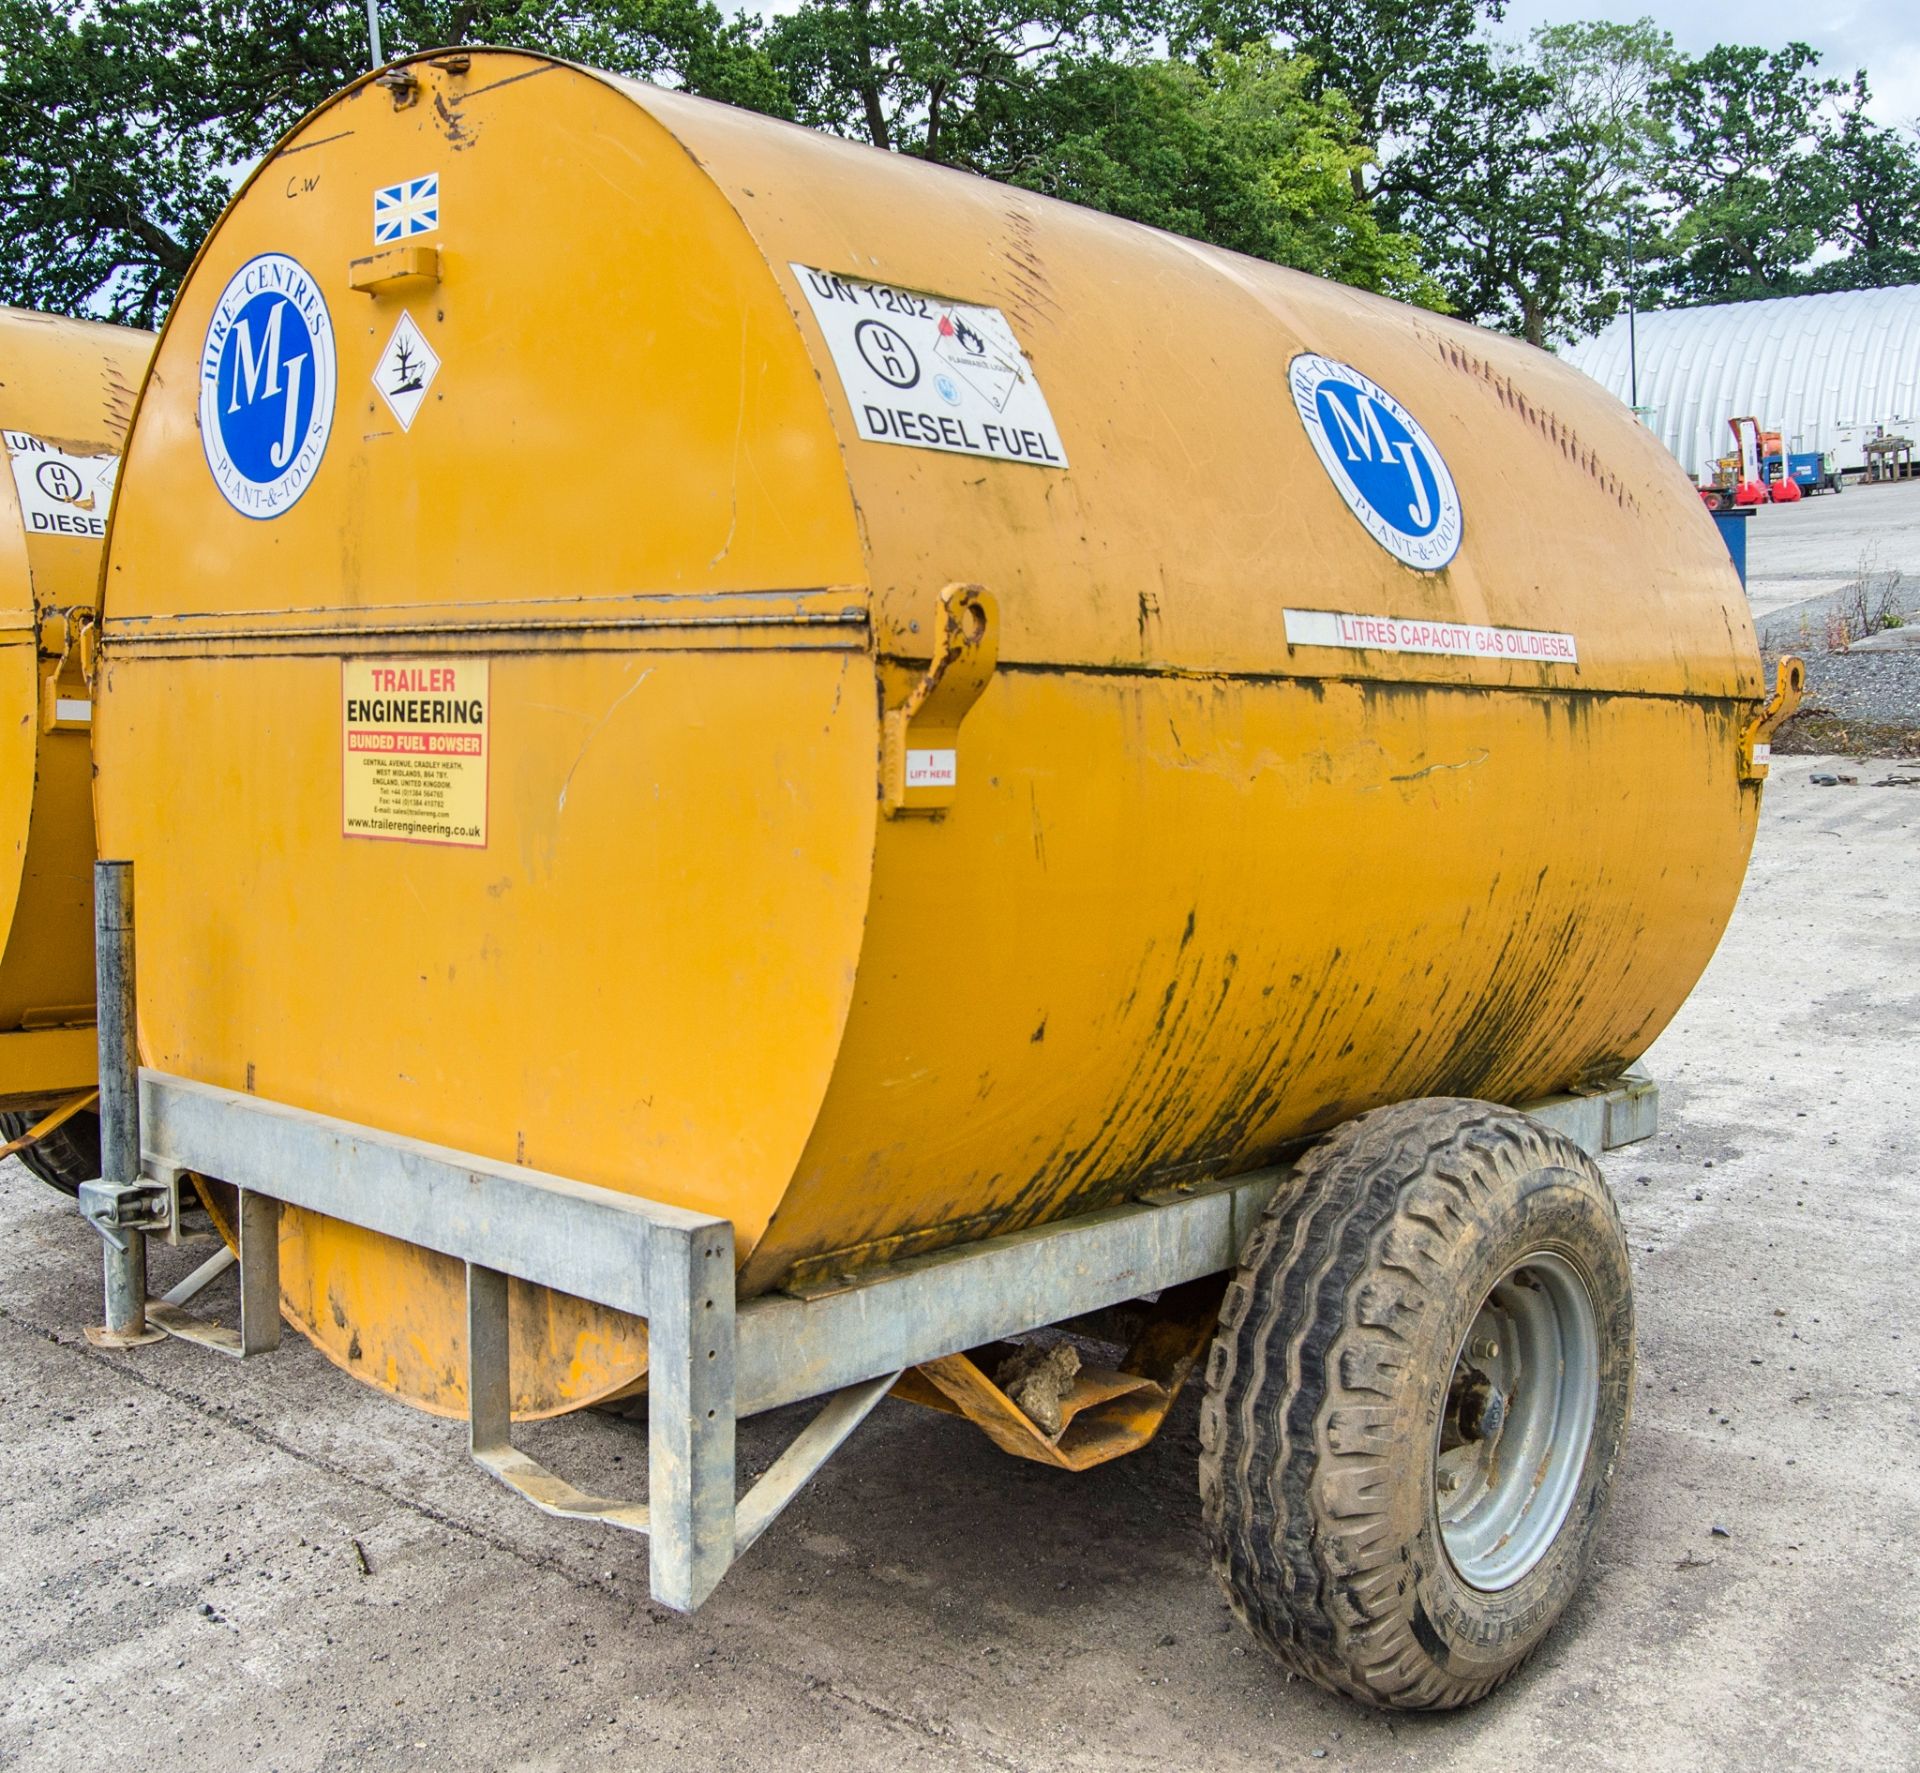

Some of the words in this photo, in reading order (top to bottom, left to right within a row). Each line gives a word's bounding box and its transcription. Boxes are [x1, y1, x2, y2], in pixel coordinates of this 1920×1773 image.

[807, 273, 858, 305] UN
[864, 286, 934, 320] 1202
[204, 299, 237, 381] HIRE
[244, 262, 326, 337] CENTRES
[227, 299, 308, 469] MJ
[1295, 367, 1319, 424] HIRE
[1311, 358, 1419, 436] CENTRES
[12, 435, 46, 453] UN
[863, 404, 980, 449] DIESEL
[982, 423, 1060, 461] FUEL
[1317, 388, 1432, 528] MJ
[31, 512, 108, 535] DIESE
[1341, 619, 1397, 644] LITRES
[1401, 624, 1471, 651] CAPACITY
[1475, 631, 1504, 652] GAS
[1507, 634, 1574, 658] OIL/DIESEL
[371, 668, 455, 692] TRAILER
[347, 700, 483, 724] ENGINEERING
[350, 734, 394, 749] BUNDED
[397, 735, 426, 750] FUEL
[429, 736, 480, 752] BOWSER
[363, 758, 387, 767] CENTRAL
[389, 759, 412, 768] AVENUE,
[414, 760, 440, 769] CRADLEY
[910, 770, 927, 779] LIFT
[401, 779, 422, 787] UNITED
[347, 817, 481, 838] www.trailerengineering.co.uk
